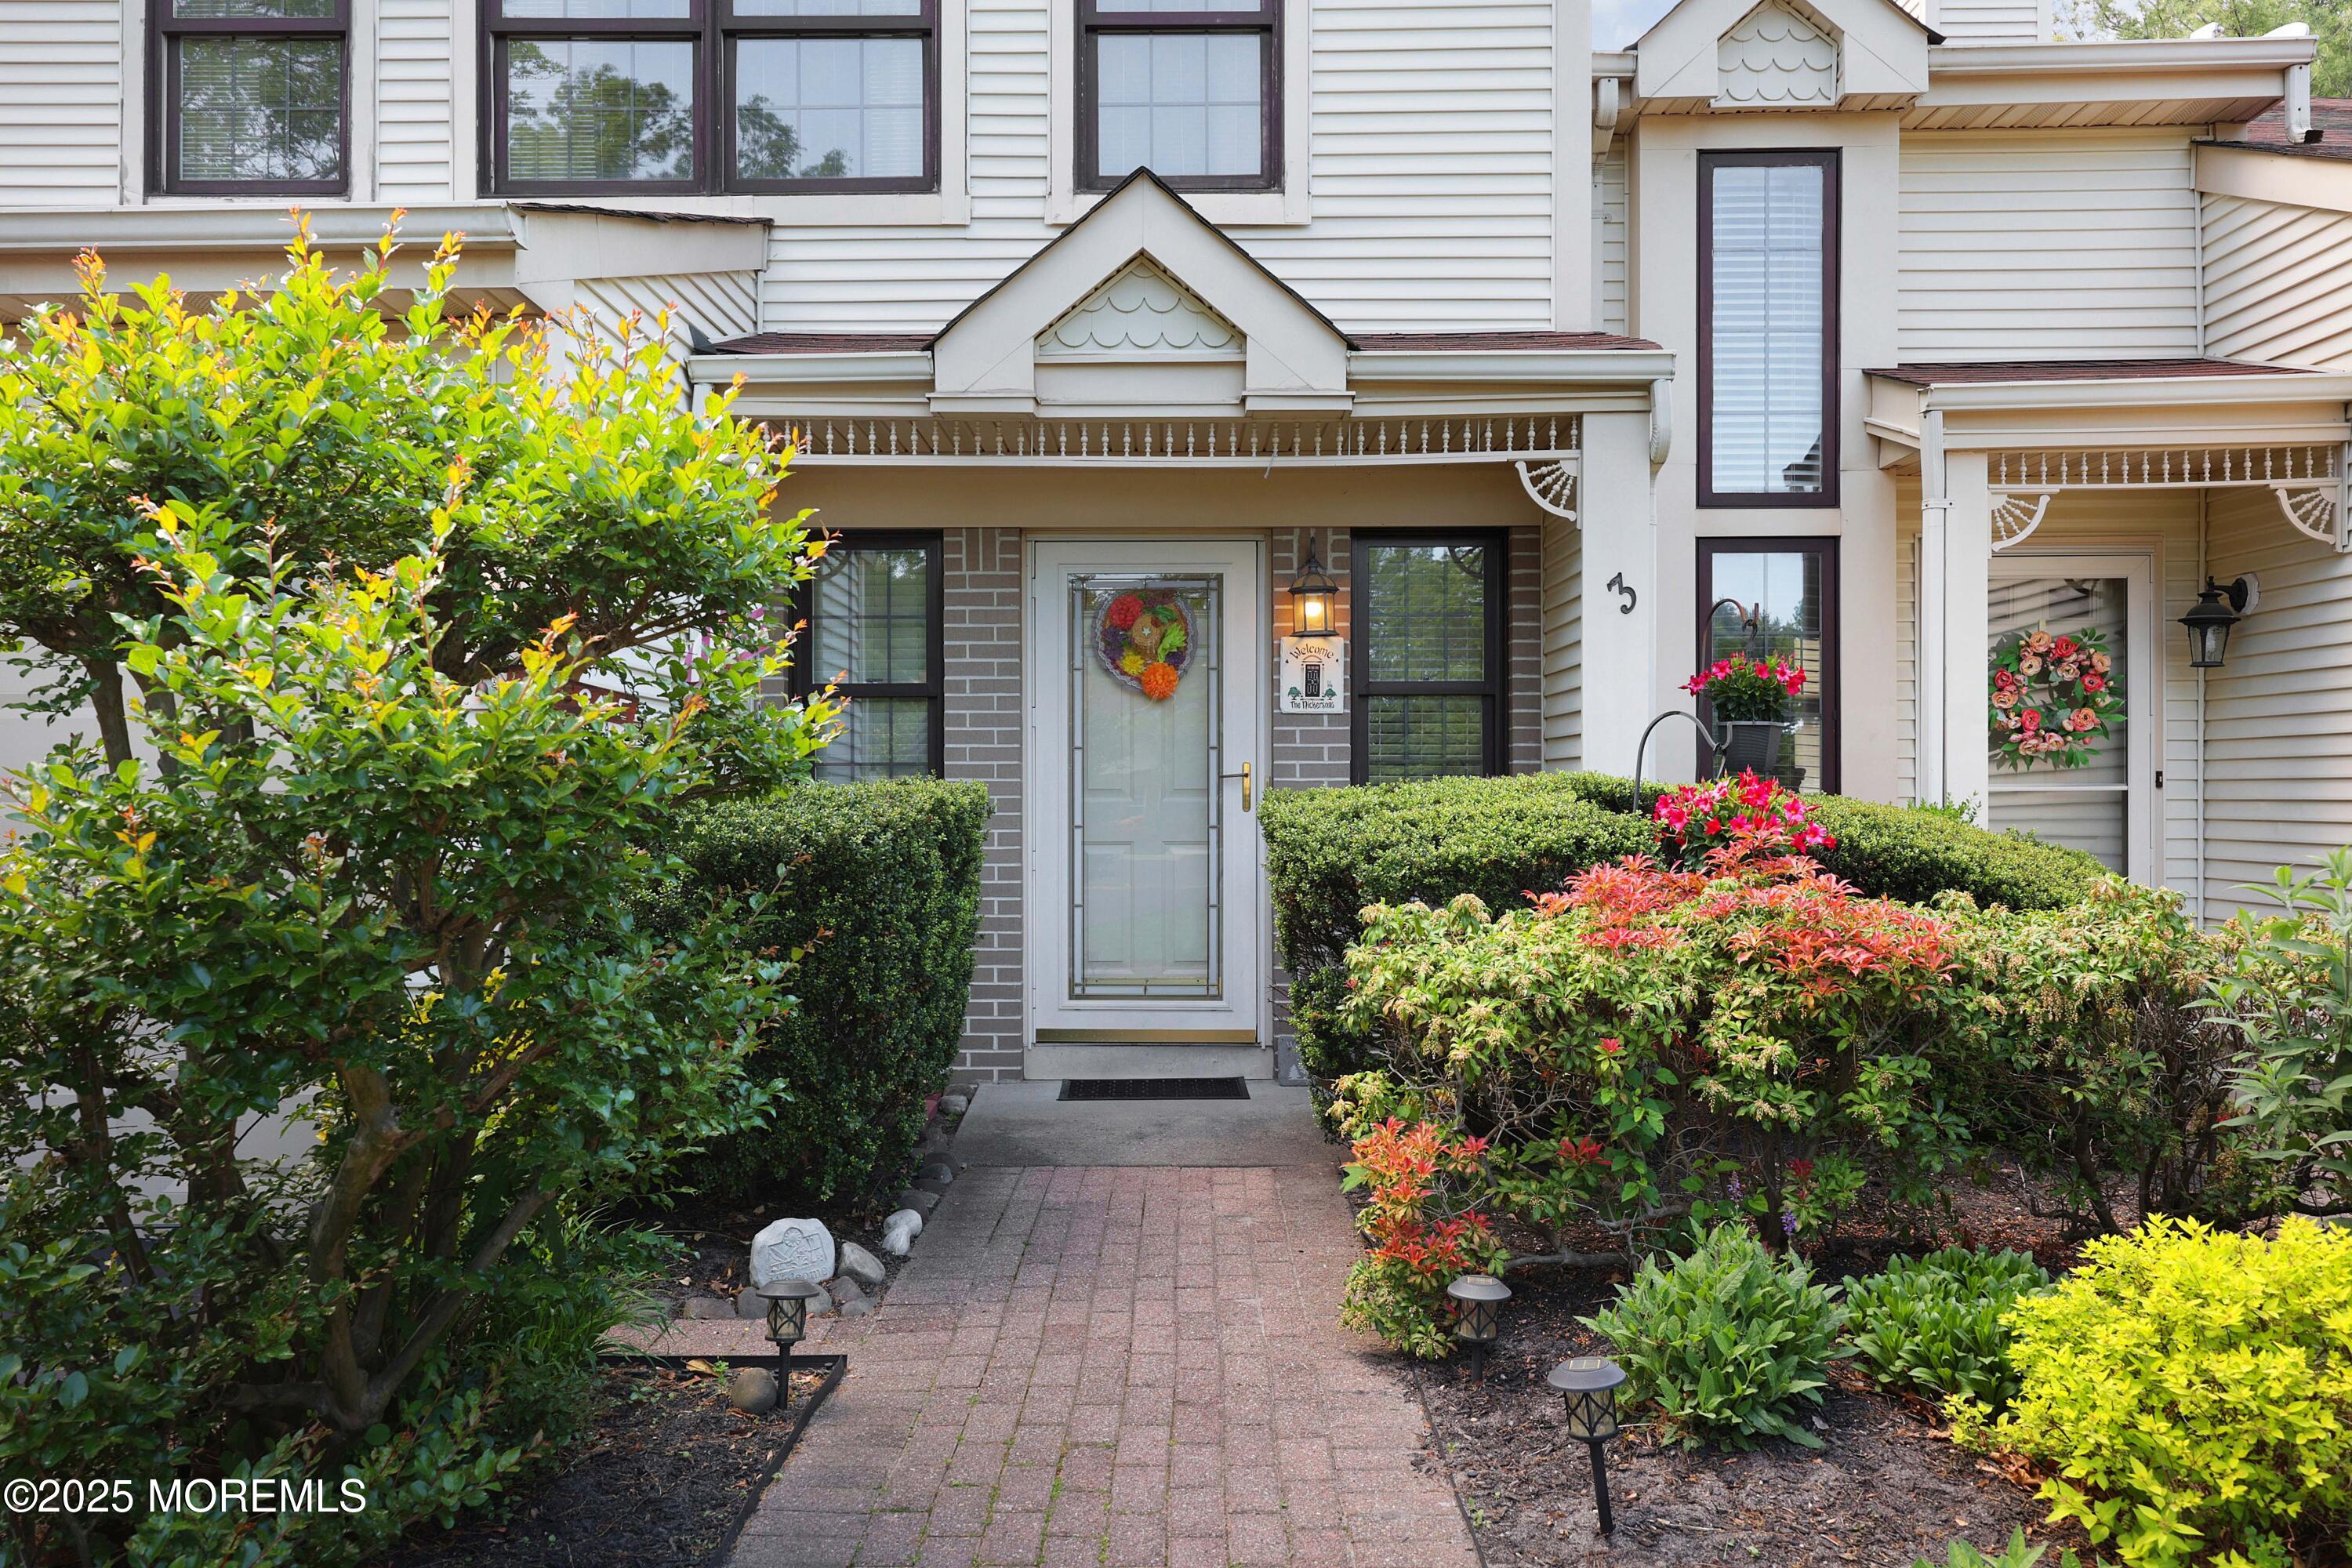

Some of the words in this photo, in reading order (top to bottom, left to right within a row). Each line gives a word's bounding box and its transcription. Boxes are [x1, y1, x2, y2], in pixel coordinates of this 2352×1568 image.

[1606, 572, 1637, 615] 3
[1290, 643, 1334, 659] Welcome
[1290, 701, 1301, 710] The
